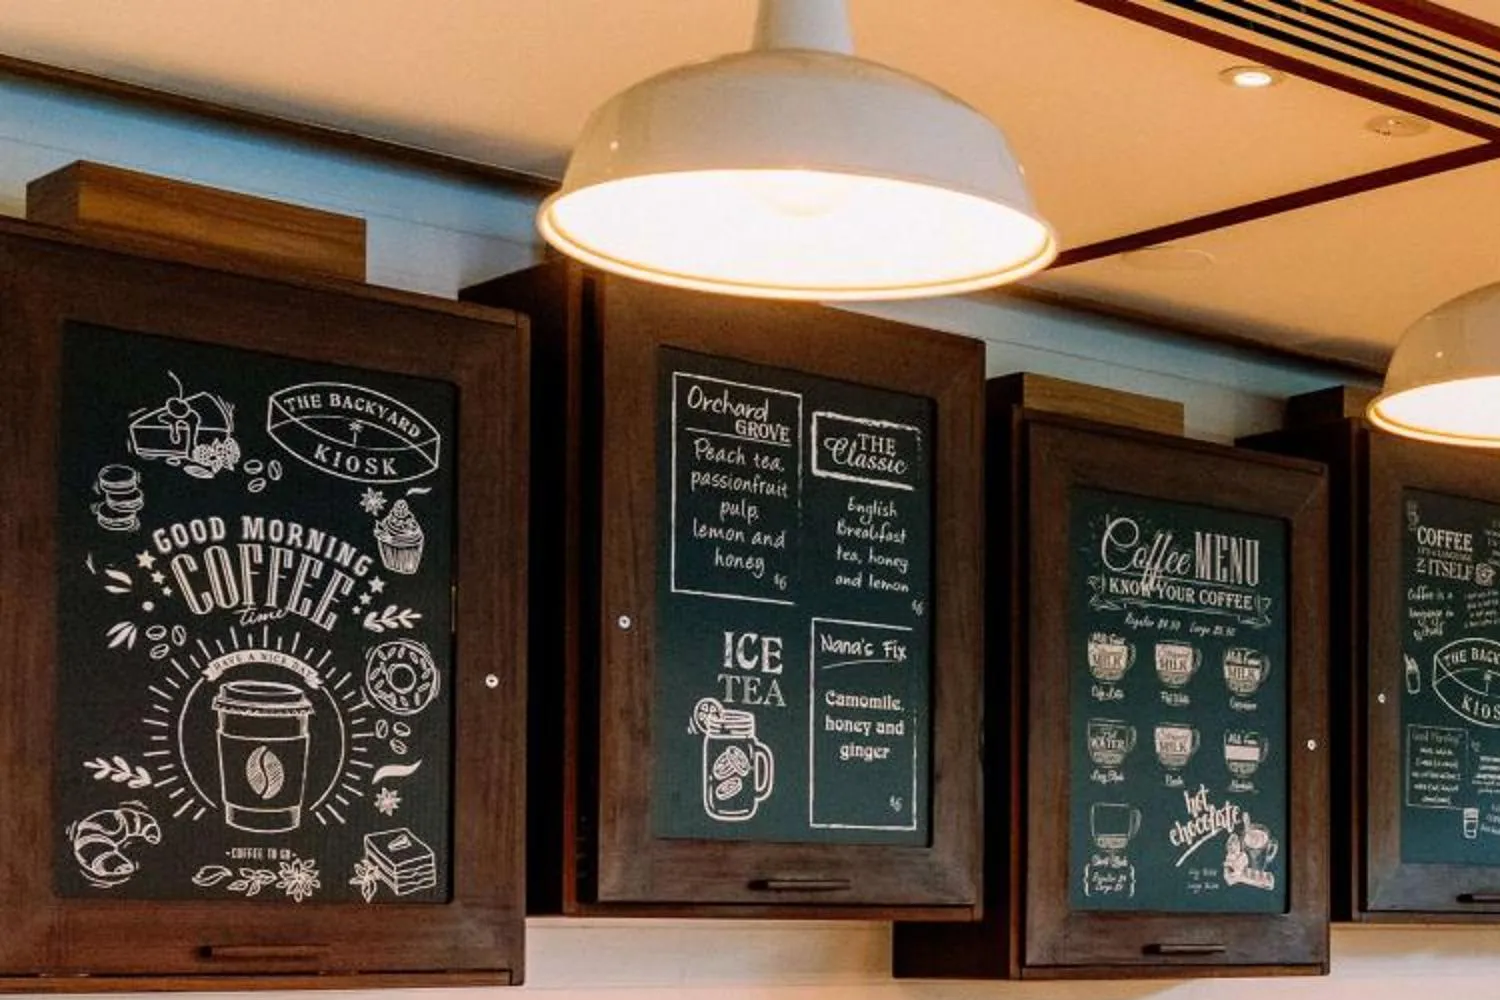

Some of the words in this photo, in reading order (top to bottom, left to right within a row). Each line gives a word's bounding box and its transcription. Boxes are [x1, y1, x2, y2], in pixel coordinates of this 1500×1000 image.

[283, 393, 323, 413] THE
[329, 393, 422, 438] BACKYARD
[687, 385, 768, 422] Orchard
[735, 420, 792, 443] GROVE
[856, 433, 897, 456] THE
[313, 443, 398, 475] KIOSK
[693, 437, 746, 465] Peach
[823, 437, 909, 475] Classic
[690, 471, 788, 498] passionfruit
[847, 495, 898, 525] English
[152, 516, 227, 553] GOOD
[241, 515, 374, 576] MORNING
[751, 530, 786, 549] and
[836, 518, 907, 544] Breakfast
[1417, 525, 1473, 553] COFFEE
[714, 548, 765, 578] honey
[868, 546, 909, 574] honey
[1101, 513, 1191, 591] Coffee
[1195, 531, 1260, 587] MENU
[170, 543, 355, 631] COFFEE
[835, 571, 862, 588] and
[1109, 577, 1152, 598] KNOW
[1156, 584, 1195, 605] YOUR
[1199, 588, 1253, 611] COFFEE
[723, 631, 784, 674] ICE
[820, 634, 874, 657] Nana's
[882, 640, 908, 660] Fix
[1443, 649, 1467, 667] THE
[717, 674, 787, 707] TEA
[825, 714, 871, 736] honey
[875, 719, 905, 736] and
[839, 742, 891, 762] ginger
[1184, 784, 1209, 817] hot
[1169, 800, 1241, 847] chocolate
